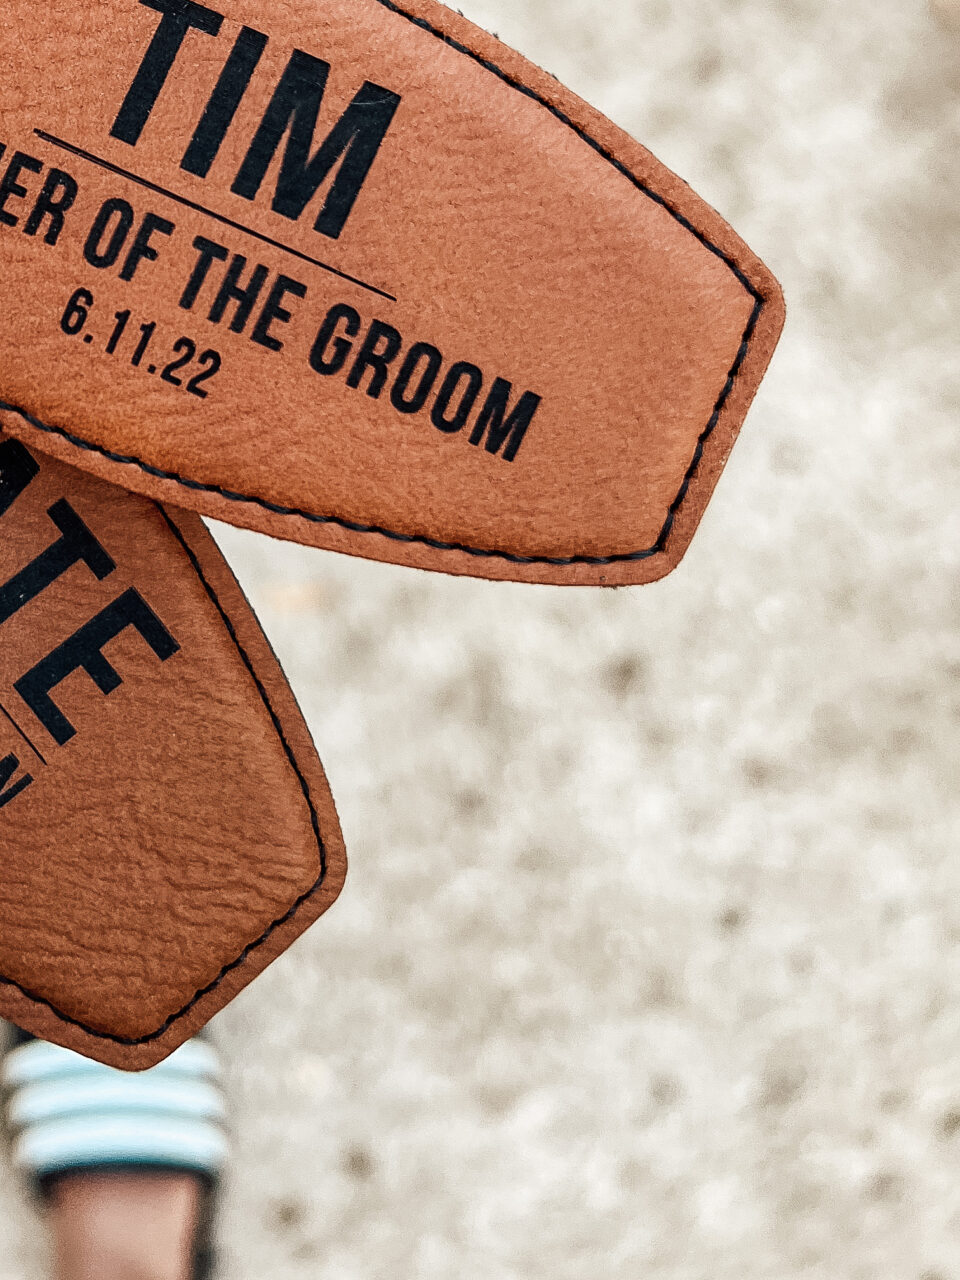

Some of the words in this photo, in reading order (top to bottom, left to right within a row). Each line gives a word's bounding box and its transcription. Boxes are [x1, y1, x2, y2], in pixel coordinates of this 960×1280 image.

[59, 287, 222, 399] 6.11.22
[82, 197, 176, 282] OF
[178, 235, 308, 352] THE
[308, 302, 543, 463] GROOM
